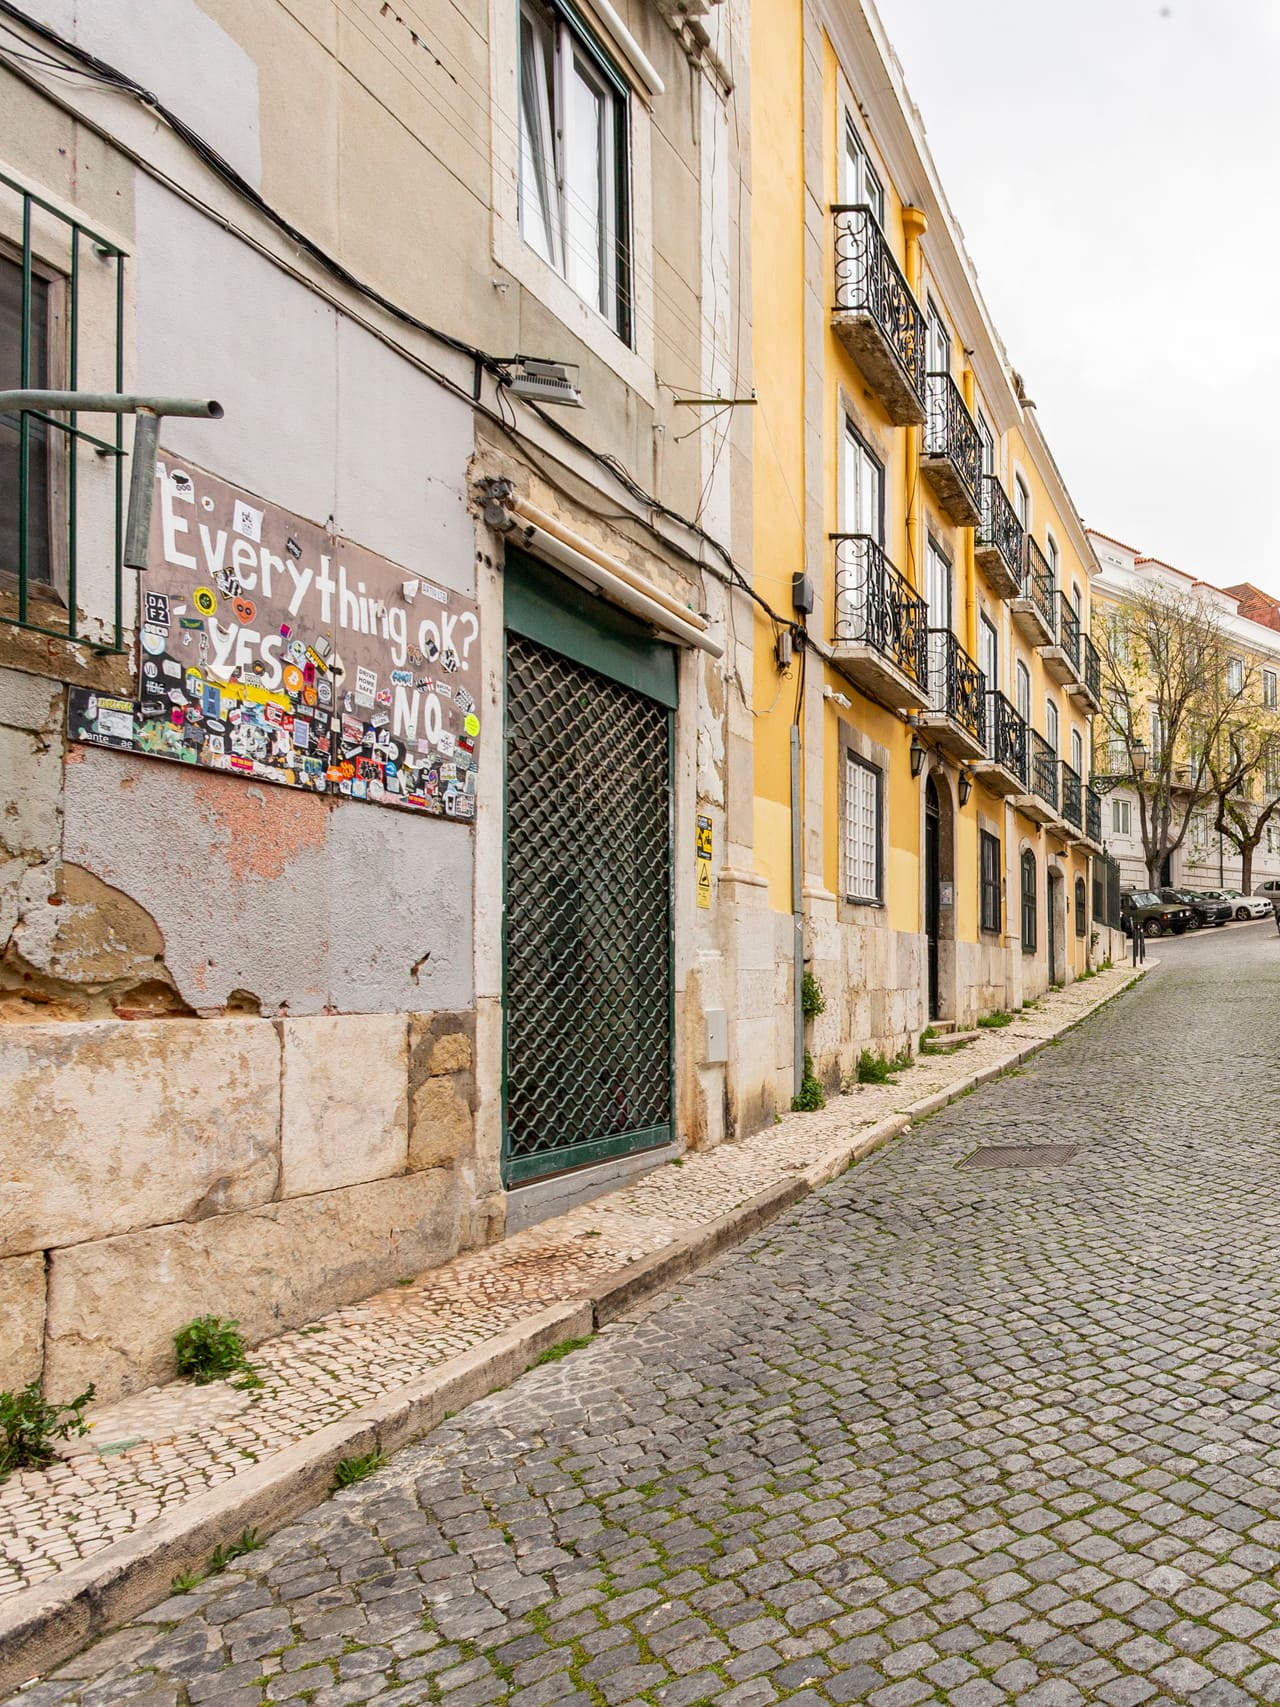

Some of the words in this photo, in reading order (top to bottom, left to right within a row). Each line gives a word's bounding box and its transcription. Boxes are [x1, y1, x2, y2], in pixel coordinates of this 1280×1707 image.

[160, 474, 408, 668] Everything
[207, 617, 284, 690] YES
[358, 676, 375, 688] HOME
[359, 684, 374, 695] SAFE
[393, 686, 442, 745] NO
